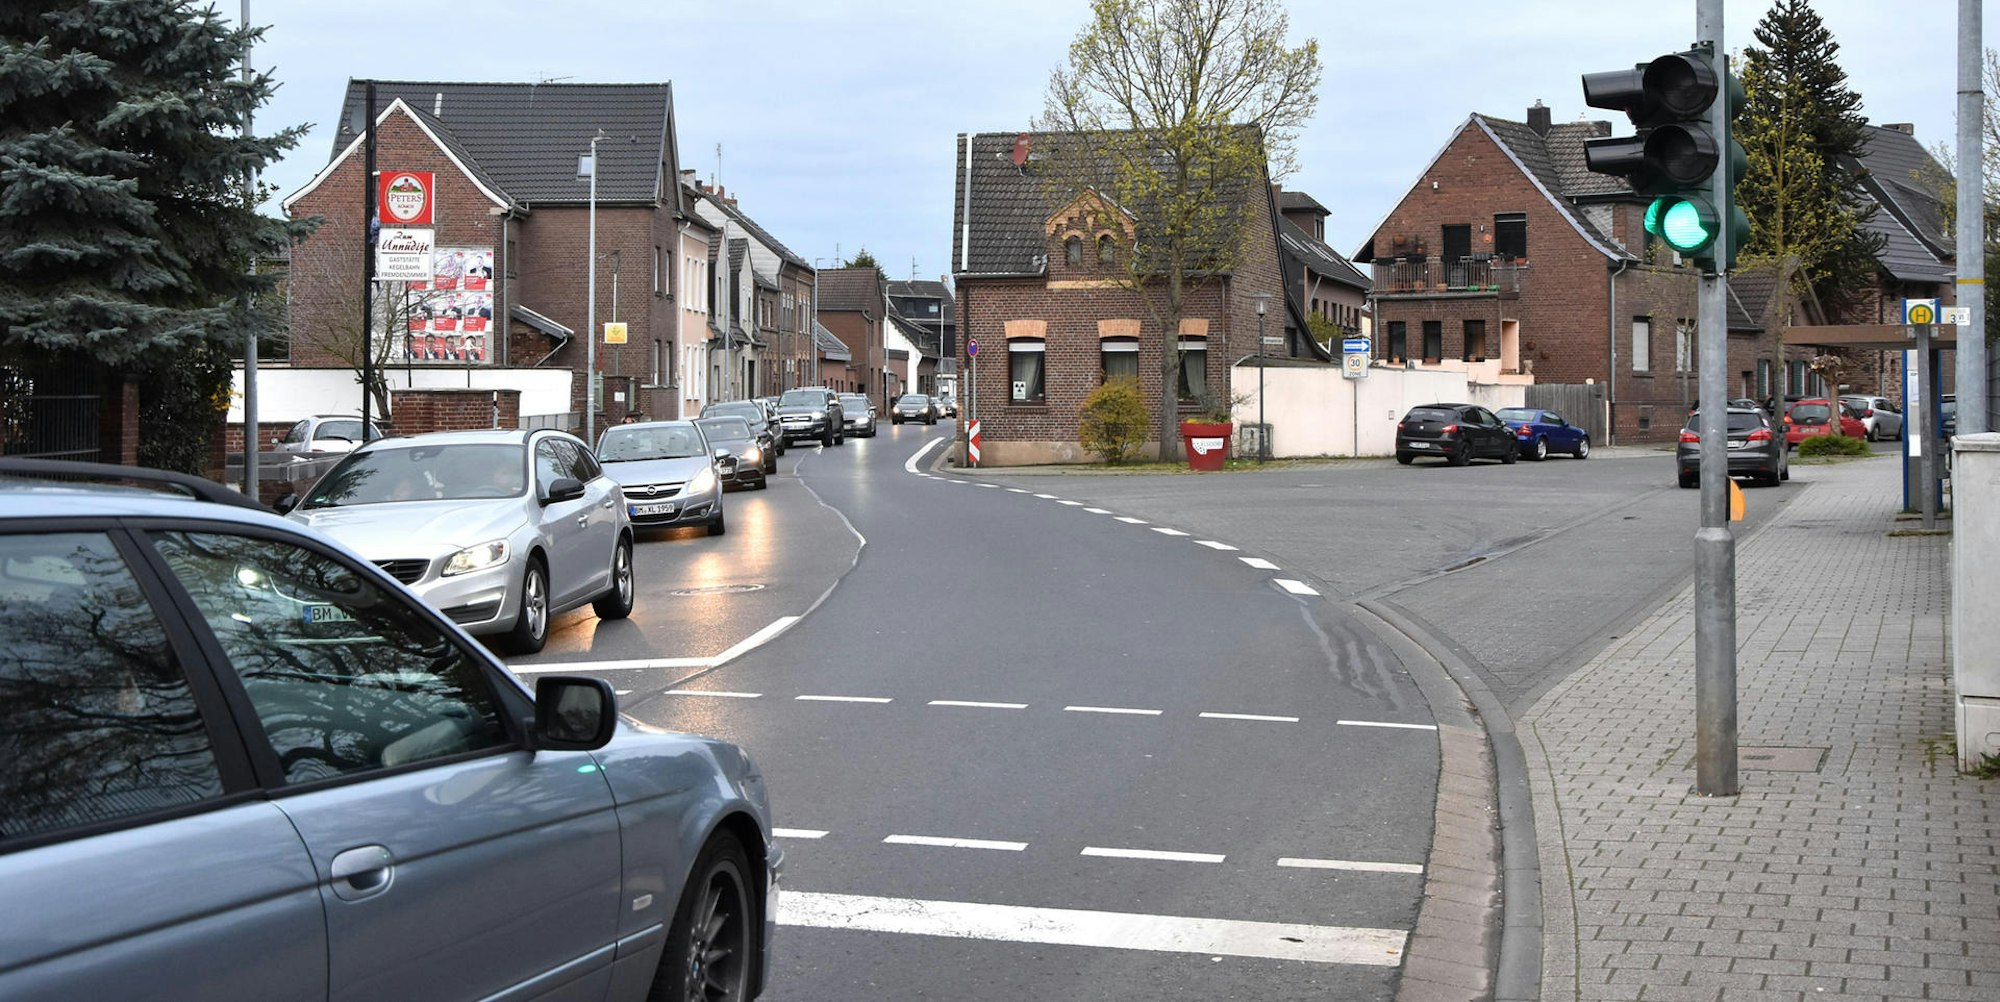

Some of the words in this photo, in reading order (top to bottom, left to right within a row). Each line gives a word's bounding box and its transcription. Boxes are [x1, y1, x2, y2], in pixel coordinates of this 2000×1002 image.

[390, 193, 422, 203] PETERS
[1916, 309, 1926, 322] H
[1350, 358, 1361, 367] 30
[312, 607, 332, 621] BM
